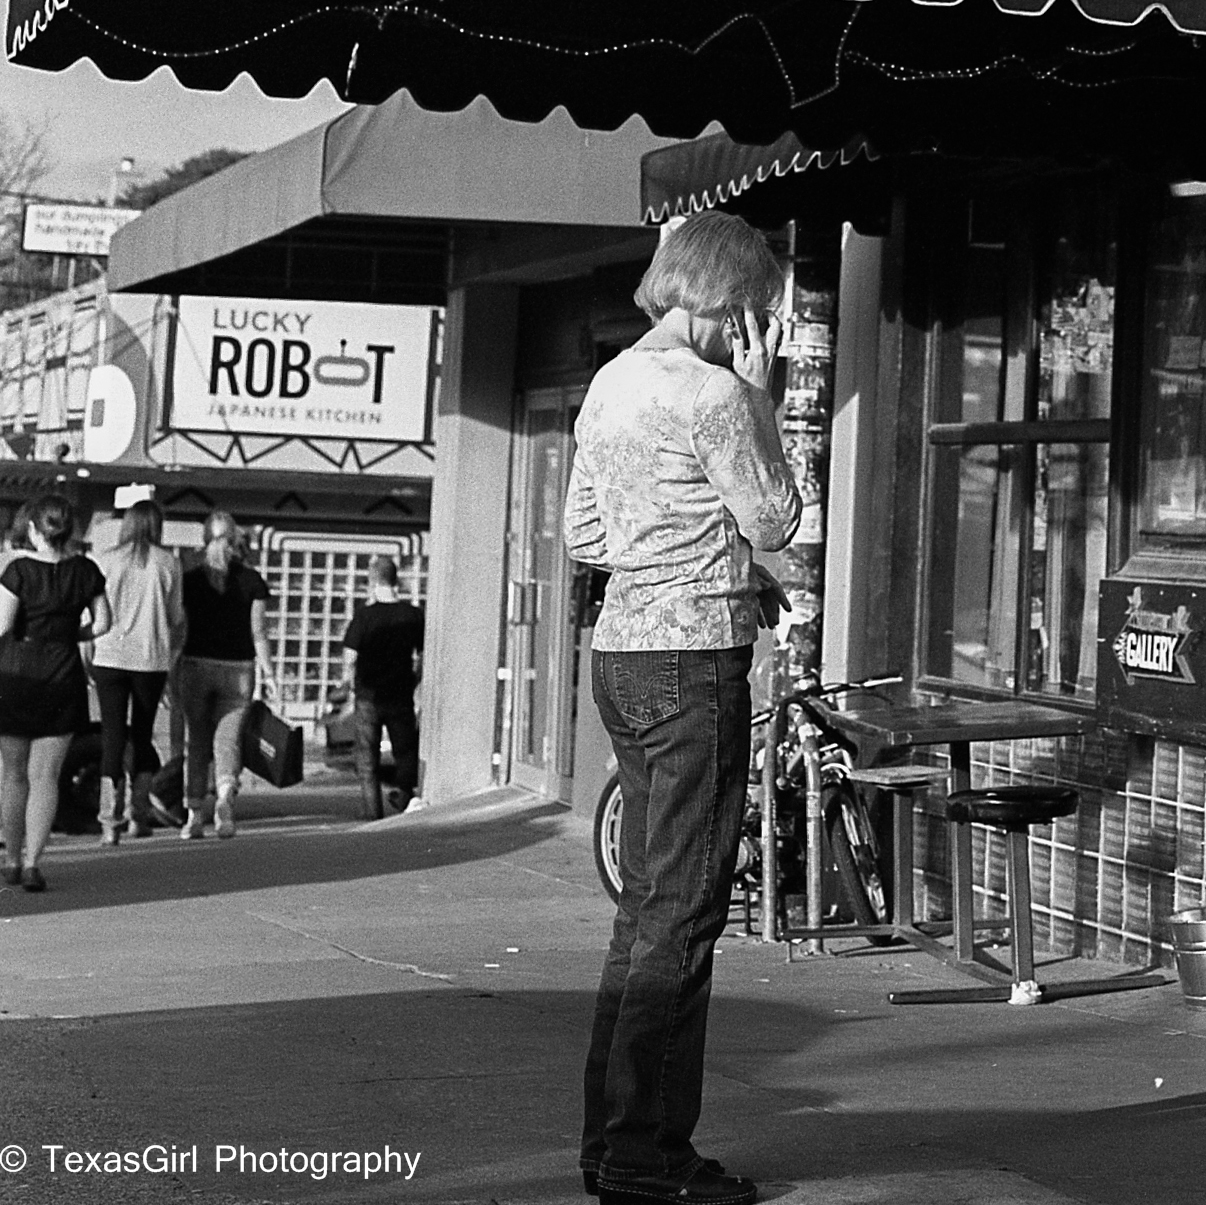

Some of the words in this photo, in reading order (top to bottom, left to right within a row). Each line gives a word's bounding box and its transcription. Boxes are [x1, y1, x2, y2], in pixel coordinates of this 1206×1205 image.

[212, 307, 314, 334] LUCKY
[208, 403, 297, 421] JAPANESE
[305, 408, 382, 424] KITCHEN
[1125, 631, 1179, 673] GALLERY
